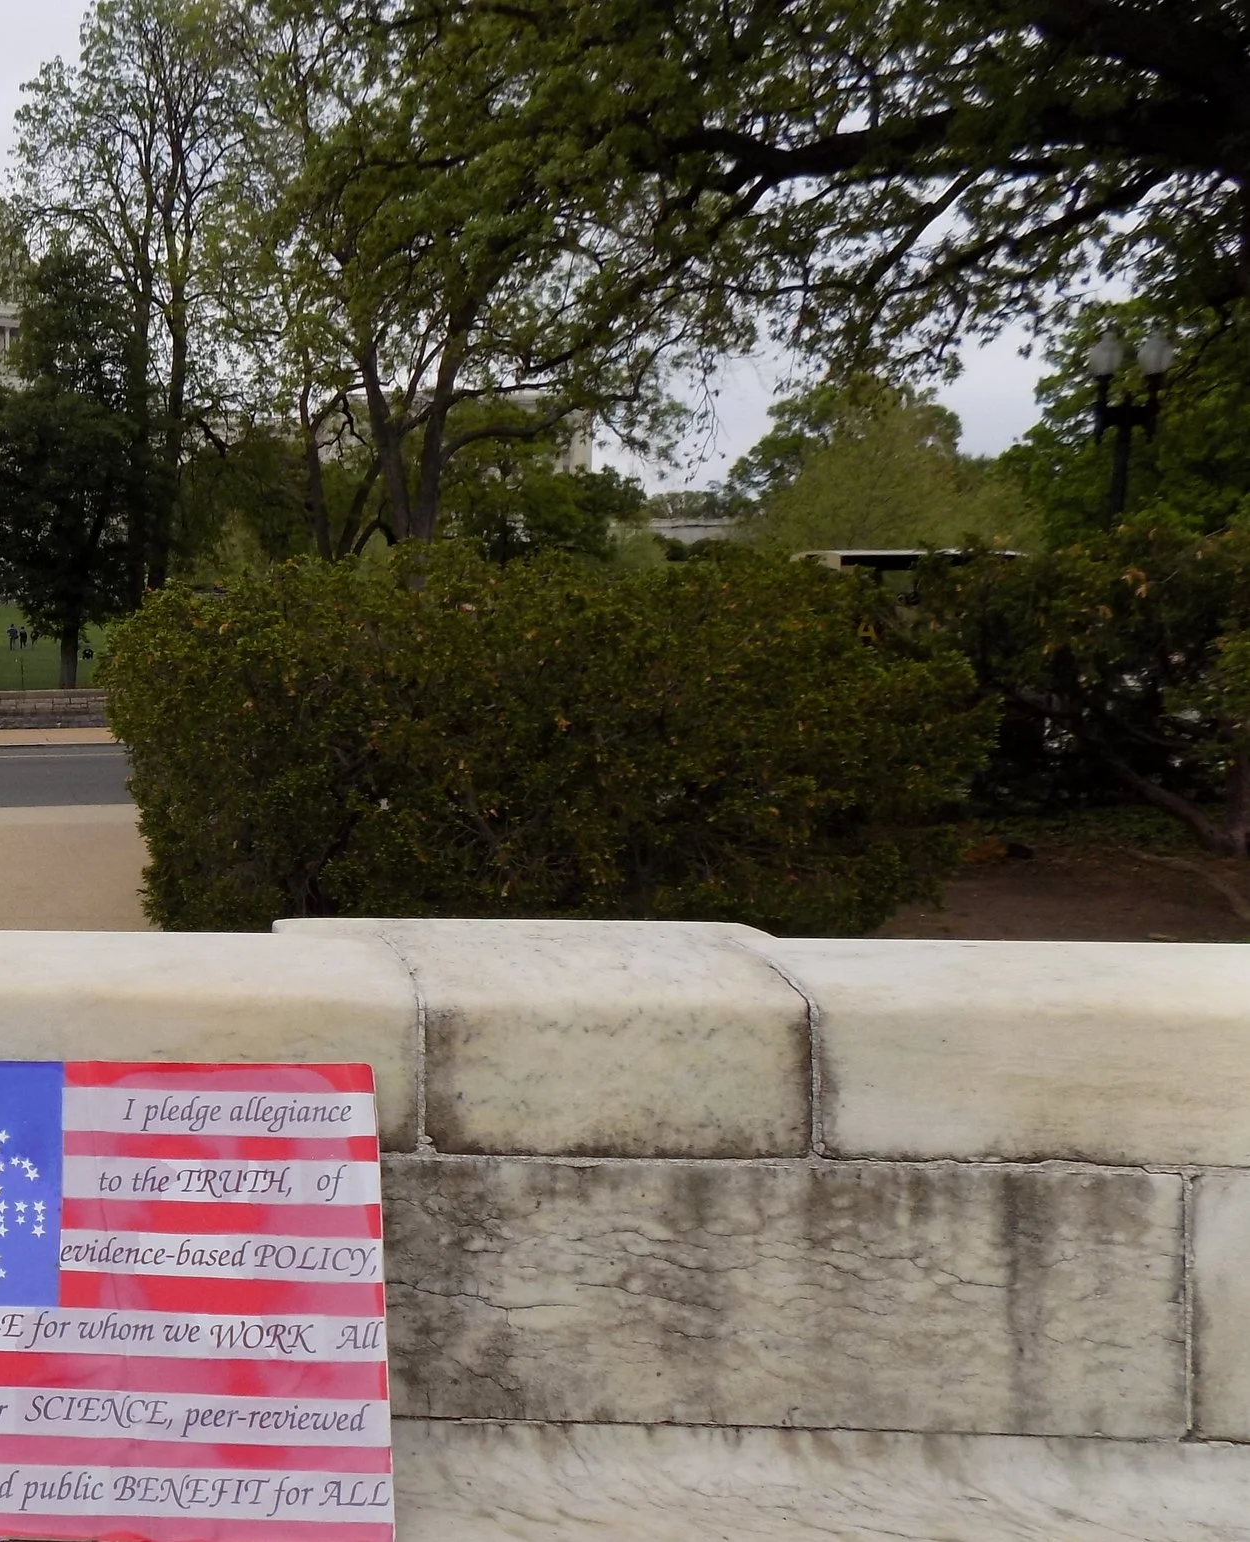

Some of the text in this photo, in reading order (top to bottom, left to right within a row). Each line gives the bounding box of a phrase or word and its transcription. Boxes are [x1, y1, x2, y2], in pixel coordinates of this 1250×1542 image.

[123, 1096, 352, 1132] I pledge allegiance
[99, 1165, 348, 1201] to the TRUTH, of
[60, 1237, 377, 1277] evidence-based POLICY,
[25, 1310, 71, 1349] for
[78, 1312, 155, 1342] whom
[163, 1323, 201, 1342] we
[210, 1320, 317, 1354] WORK
[336, 1321, 384, 1350] All
[24, 1395, 174, 1430] SCIENCE,
[181, 1403, 370, 1437] peer-reviewed
[18, 1472, 104, 1511] public
[113, 1475, 271, 1510] BENEFIT
[266, 1475, 314, 1517] for
[319, 1479, 391, 1507] ALL
